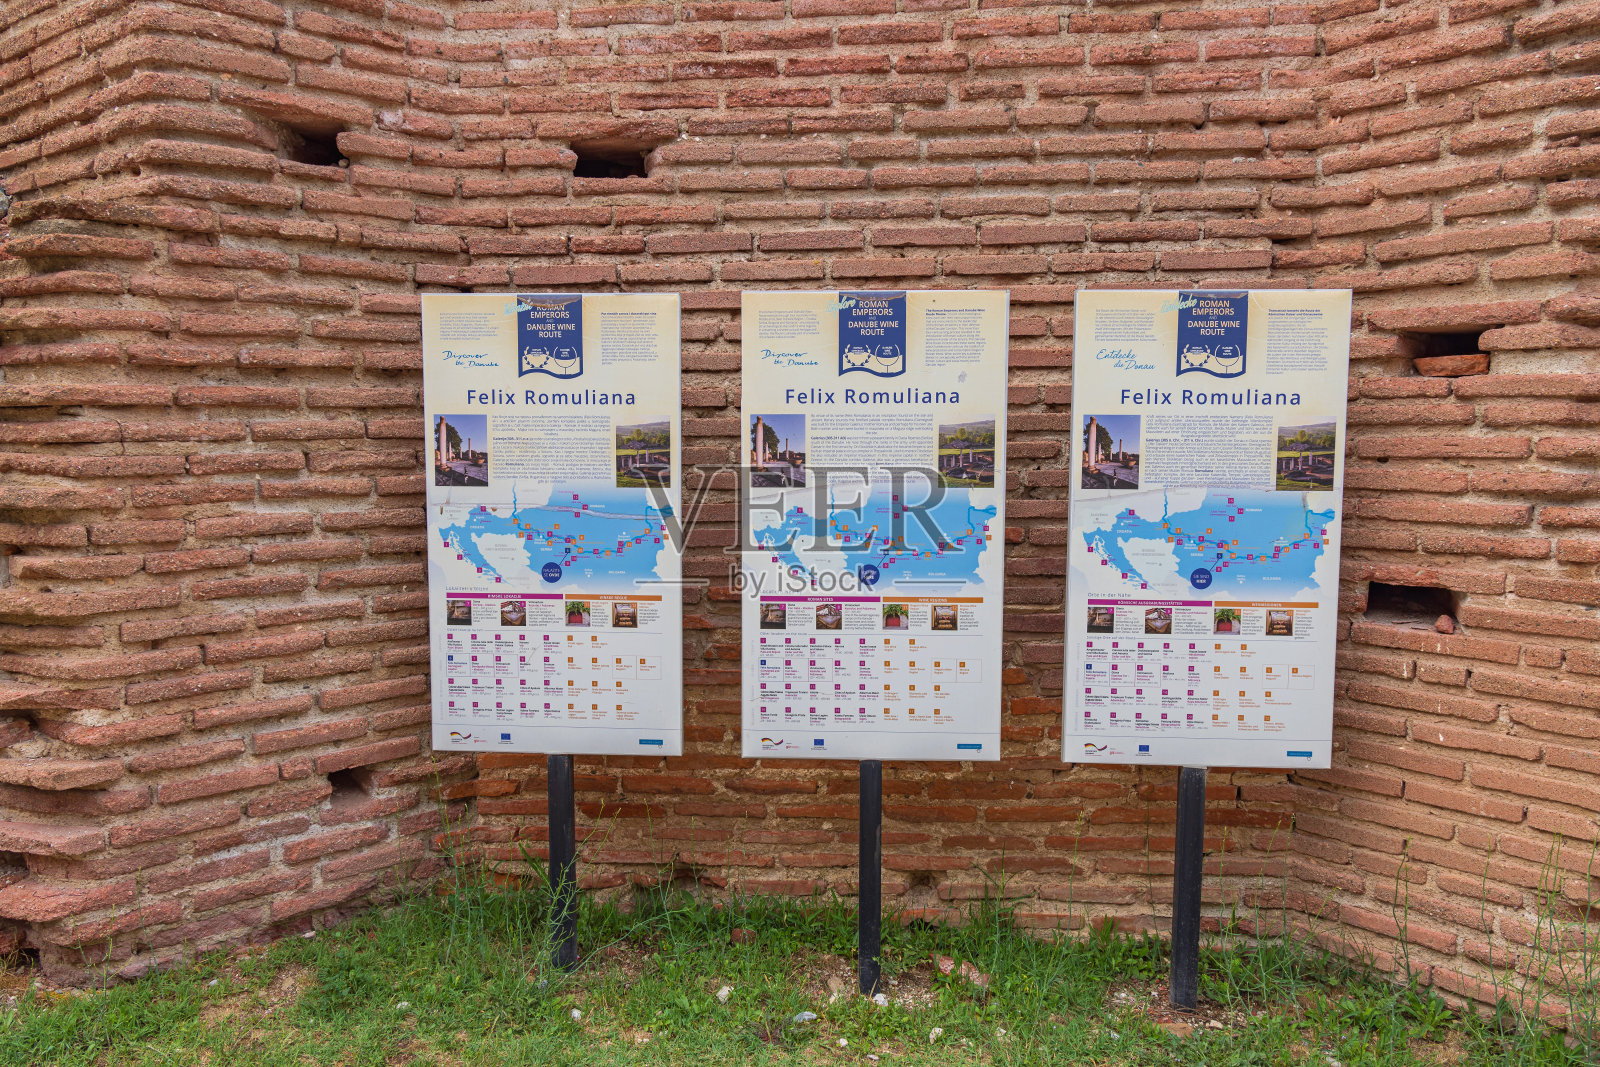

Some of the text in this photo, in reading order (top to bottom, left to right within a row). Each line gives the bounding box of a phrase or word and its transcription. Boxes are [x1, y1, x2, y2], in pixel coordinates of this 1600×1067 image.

[442, 350, 488, 360] Discover
[760, 349, 808, 359] Discover
[1096, 348, 1136, 360] Entdecke
[1125, 360, 1155, 370] Donau
[467, 389, 635, 405] Felix Romuliana
[786, 389, 960, 404] Felix Romuliana
[1121, 389, 1301, 405] Felix Romuliana
